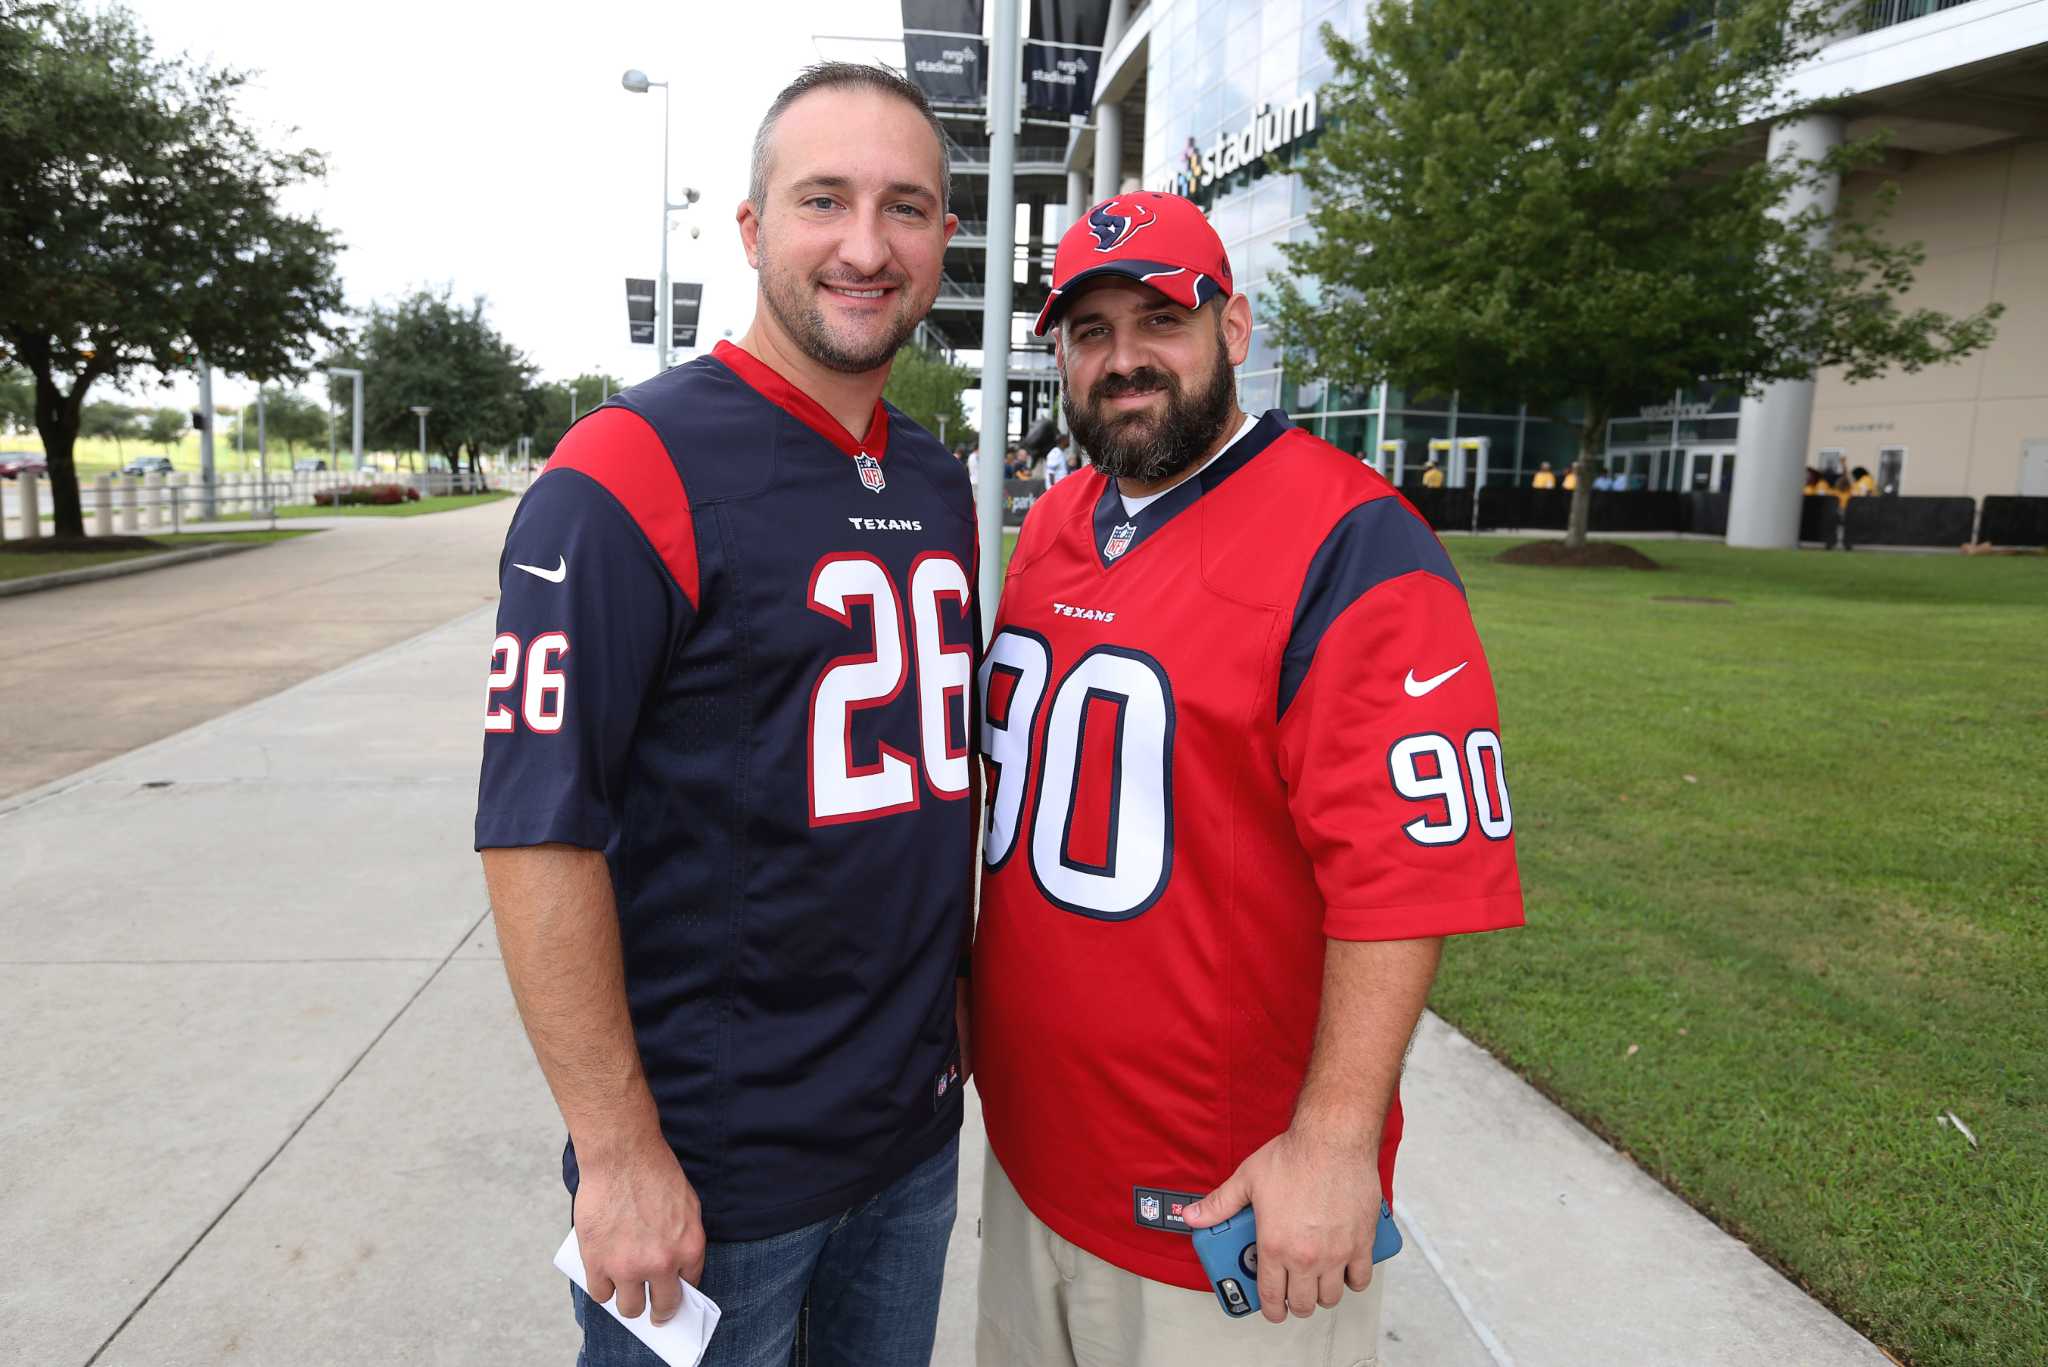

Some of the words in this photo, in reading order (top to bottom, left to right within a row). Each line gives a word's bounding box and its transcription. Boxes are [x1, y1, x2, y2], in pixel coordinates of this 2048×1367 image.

[915, 60, 964, 75] stadium
[1031, 69, 1077, 85] stadium
[1201, 91, 1317, 187] stadium
[863, 469, 883, 485] NFL
[848, 517, 922, 531] TEXANS
[1109, 538, 1127, 553] NFL
[1053, 602, 1116, 623] TEXANS
[484, 630, 571, 734] 26
[807, 550, 972, 828] 26
[977, 625, 1175, 921] 90
[1387, 729, 1513, 848] 90
